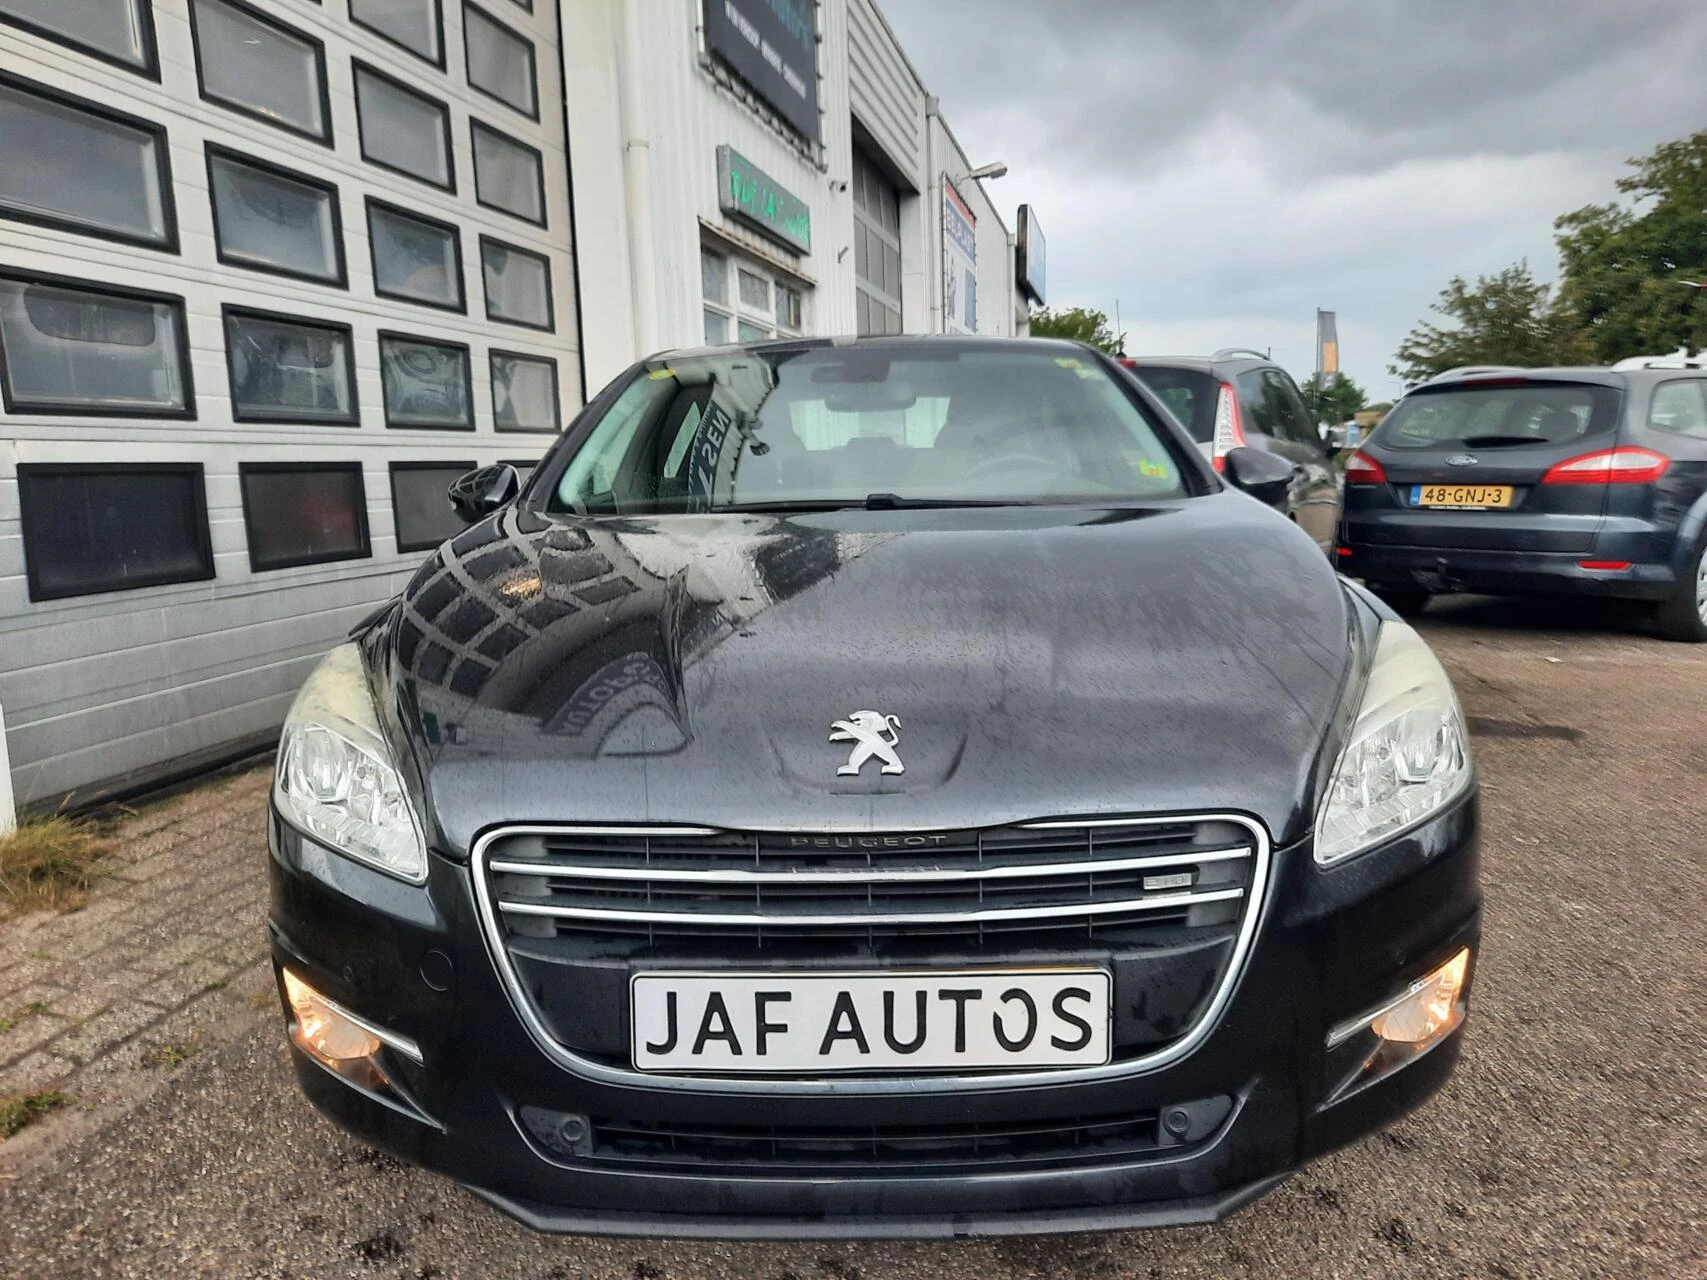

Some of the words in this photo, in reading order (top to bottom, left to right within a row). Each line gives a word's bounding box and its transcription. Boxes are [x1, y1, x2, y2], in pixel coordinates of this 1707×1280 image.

[1425, 488, 1503, 503] 48-GNJ-3
[790, 835, 947, 848] PEUGEOT
[646, 990, 792, 1056] JAF
[819, 986, 1093, 1055] AUTOS
